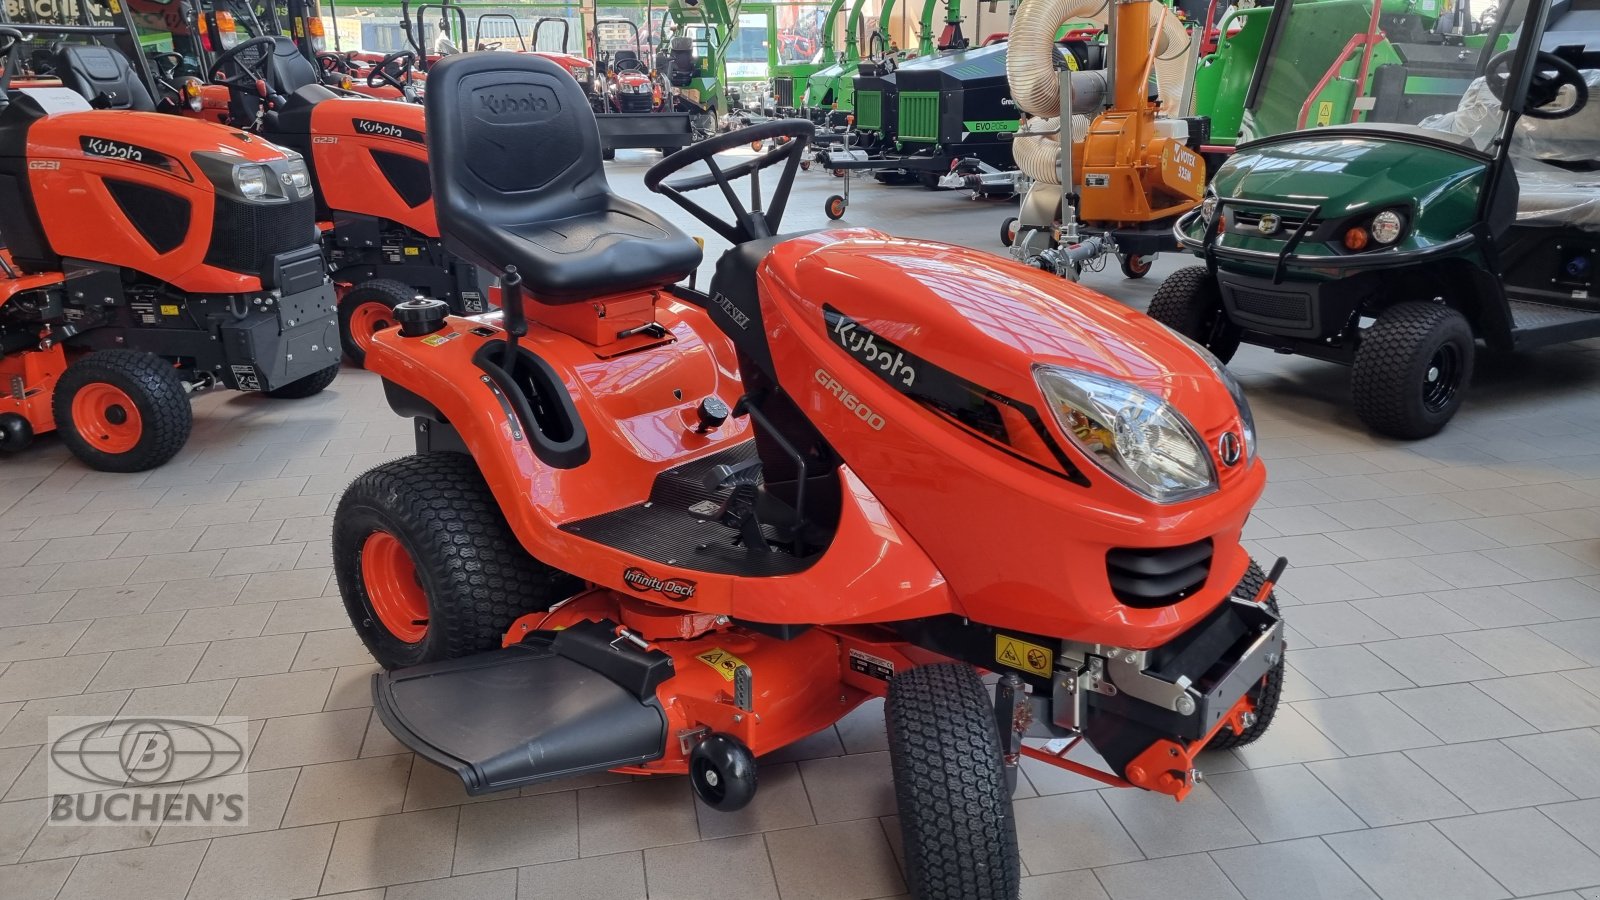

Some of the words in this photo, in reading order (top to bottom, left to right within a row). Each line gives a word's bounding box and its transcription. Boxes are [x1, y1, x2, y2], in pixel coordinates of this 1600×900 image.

[480, 92, 549, 115] Kubota
[312, 136, 338, 144] G231
[359, 120, 403, 137] Kubota
[89, 138, 142, 161] Kubota
[29, 160, 61, 170] G231
[711, 291, 750, 330] DIESEL
[834, 316, 916, 387] Kubota
[814, 368, 886, 431] GR1600
[624, 570, 664, 591] Infinity
[665, 581, 696, 597] Deck
